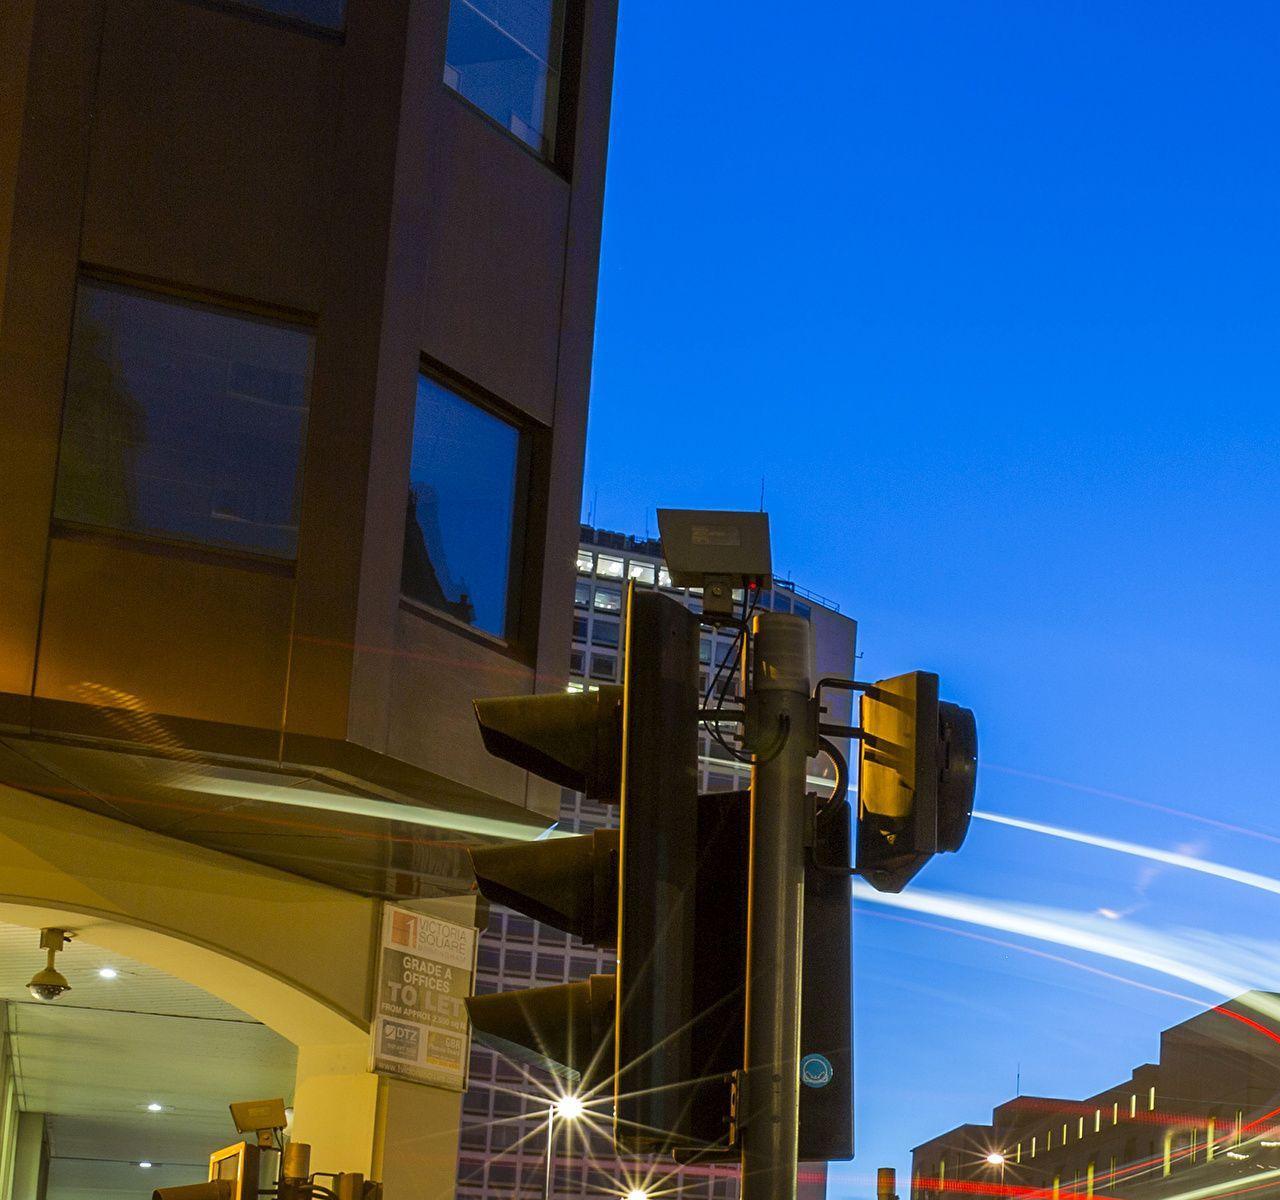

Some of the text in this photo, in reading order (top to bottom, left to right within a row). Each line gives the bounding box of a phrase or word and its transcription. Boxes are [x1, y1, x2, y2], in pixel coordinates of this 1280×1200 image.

[407, 919, 466, 949] 1 VICTORIA
[419, 931, 467, 956] SQUARE
[403, 956, 453, 981] GRADE A
[403, 971, 450, 993] OFFICES
[381, 1002, 402, 1014] FROM
[388, 981, 465, 1017] TO LET
[396, 1027, 417, 1041] DTZ
